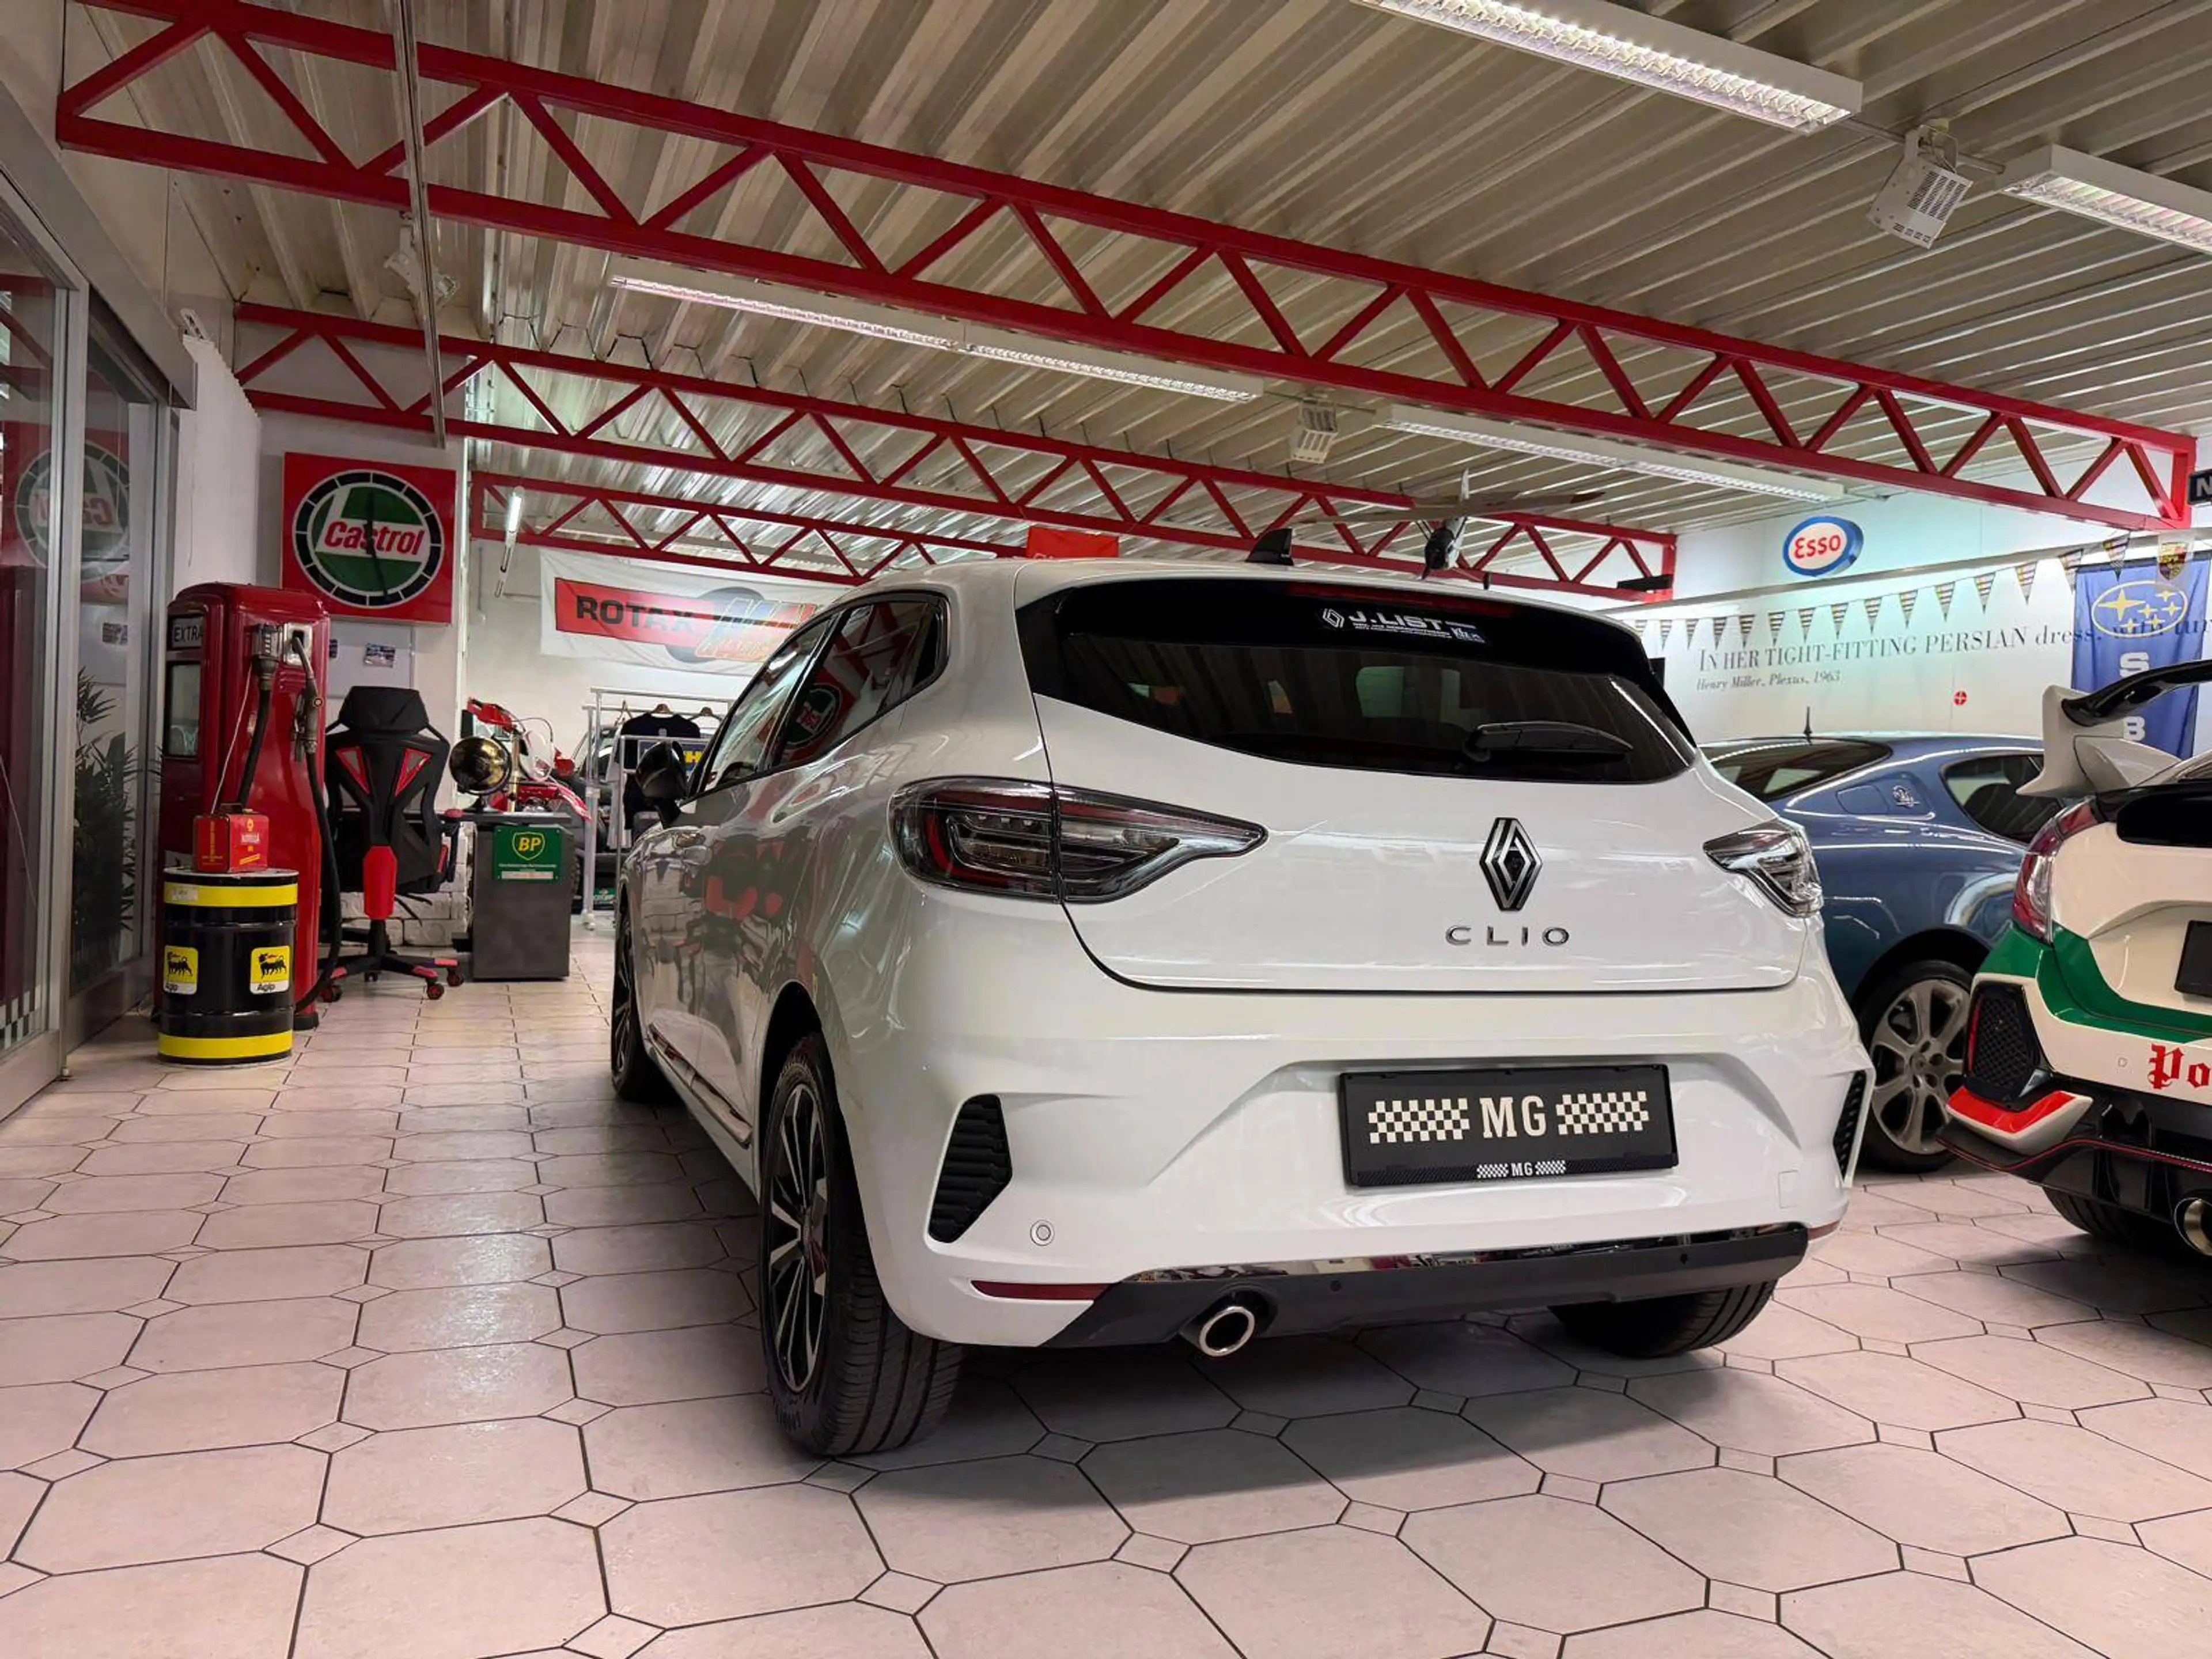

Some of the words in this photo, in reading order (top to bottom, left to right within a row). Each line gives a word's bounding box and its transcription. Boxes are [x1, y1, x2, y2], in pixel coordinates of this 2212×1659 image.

[324, 521, 425, 555] Castrol
[576, 595, 695, 631] ROTAX
[1724, 650, 1759, 669] HER
[1764, 635, 1916, 667] TIGHT-FITTING
[1925, 626, 2027, 654] PERSIAN
[1696, 678, 1728, 692] Henry
[519, 837, 541, 851] BP
[1445, 925, 1570, 946] CLIO
[1479, 1096, 1547, 1138] MG
[1510, 1162, 1533, 1176] MG
